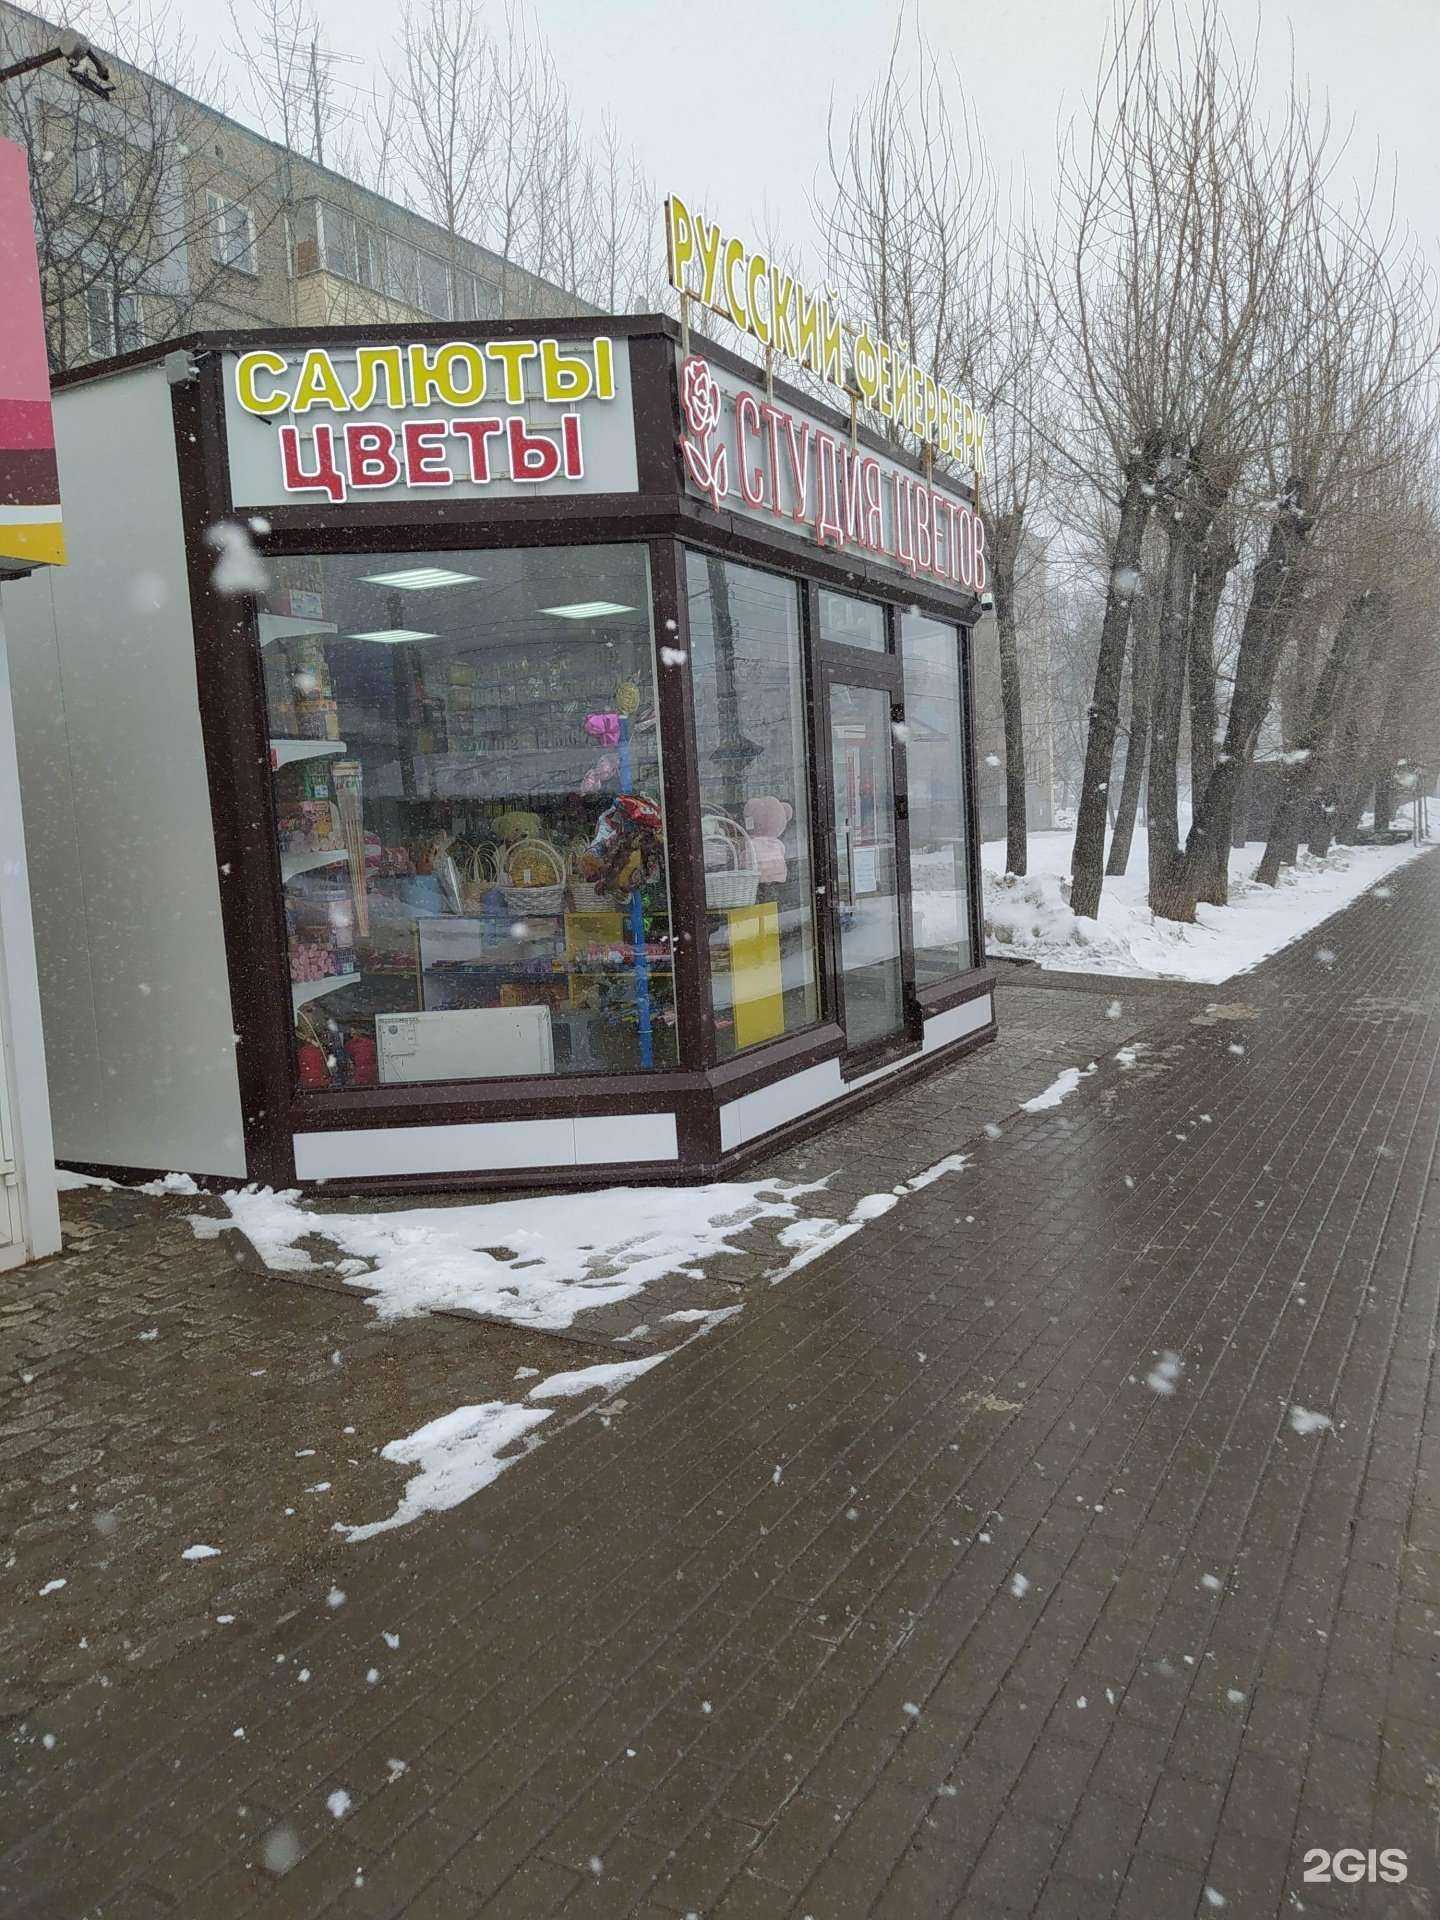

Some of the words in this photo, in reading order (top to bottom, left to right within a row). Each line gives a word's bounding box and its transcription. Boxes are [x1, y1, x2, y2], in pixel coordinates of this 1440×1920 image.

[235, 336, 616, 416] САЛЮТЫ
[666, 192, 844, 388] РУССКИЙ
[853, 321, 989, 475] ФЕЙЕРВЕРК
[278, 413, 585, 503] ЦВЕТЫ
[736, 391, 885, 553] СТУДИЯ
[892, 470, 988, 591] ЦВЕТОВ
